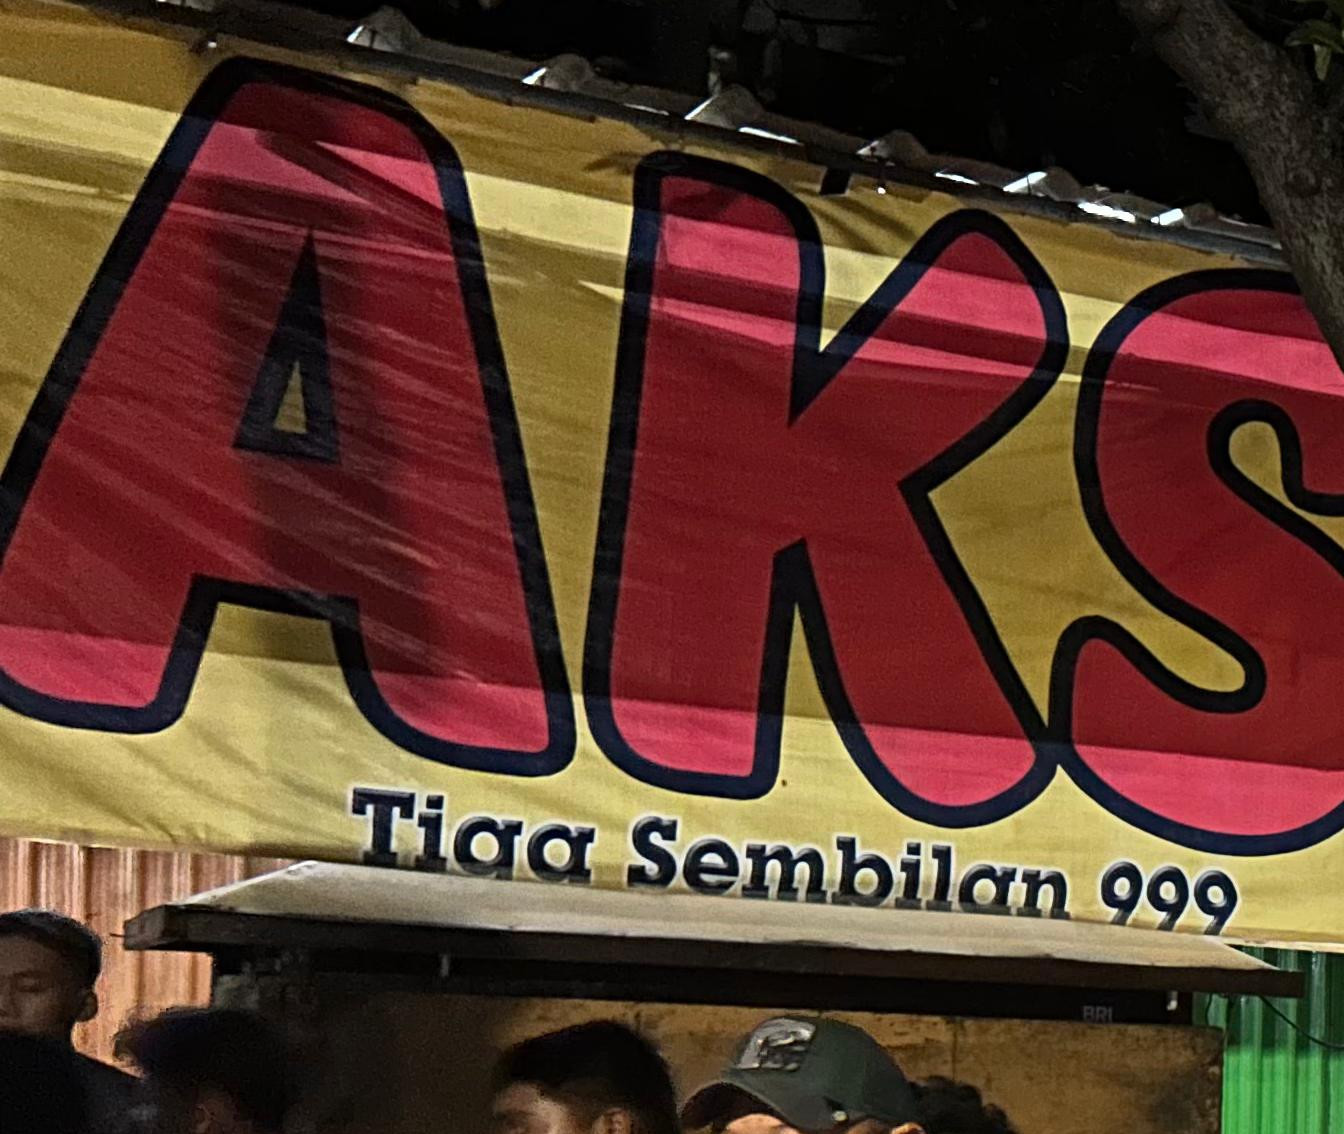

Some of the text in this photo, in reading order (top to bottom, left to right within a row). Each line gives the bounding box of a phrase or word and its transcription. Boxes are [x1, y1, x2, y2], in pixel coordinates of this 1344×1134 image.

[352, 787, 1248, 937] Tiga Sembilan 999
